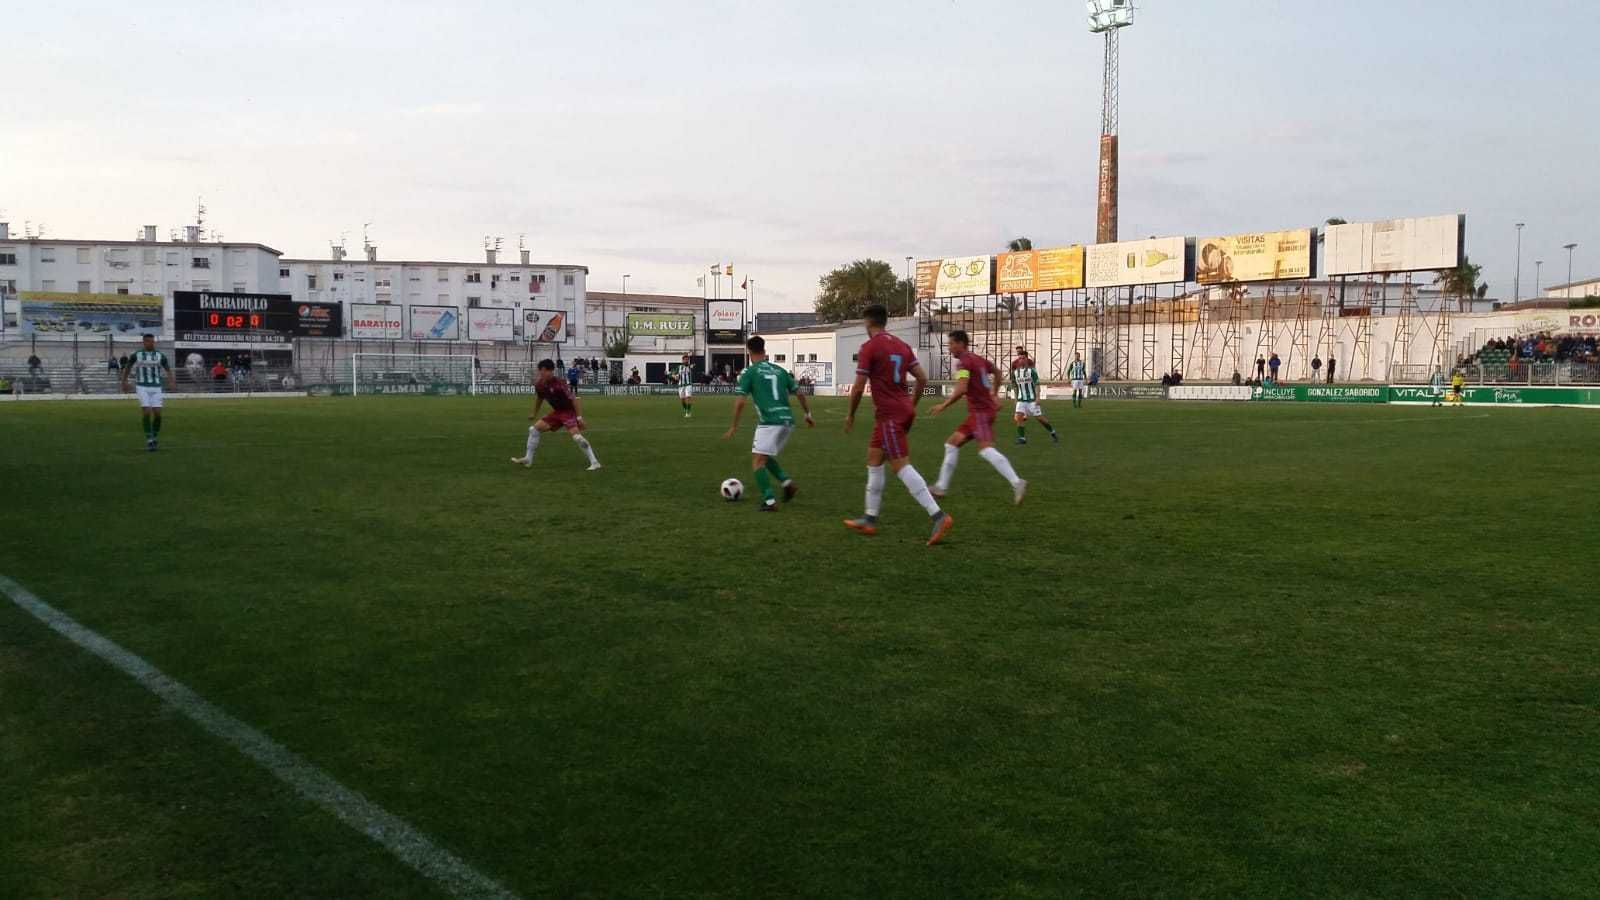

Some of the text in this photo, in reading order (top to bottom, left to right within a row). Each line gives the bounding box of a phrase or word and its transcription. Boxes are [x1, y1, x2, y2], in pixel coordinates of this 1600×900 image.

[199, 294, 268, 311] BARBADILLO
[210, 313, 218, 325] 0
[226, 315, 243, 327] 02
[353, 319, 401, 329] BARATITO
[632, 320, 657, 330] J.M.
[1569, 315, 1600, 327] RO
[889, 354, 903, 384] 7
[763, 374, 780, 401] 7
[1263, 388, 1296, 396] INCLUYE
[1307, 388, 1380, 397] GONZALEZ SABORIDO
